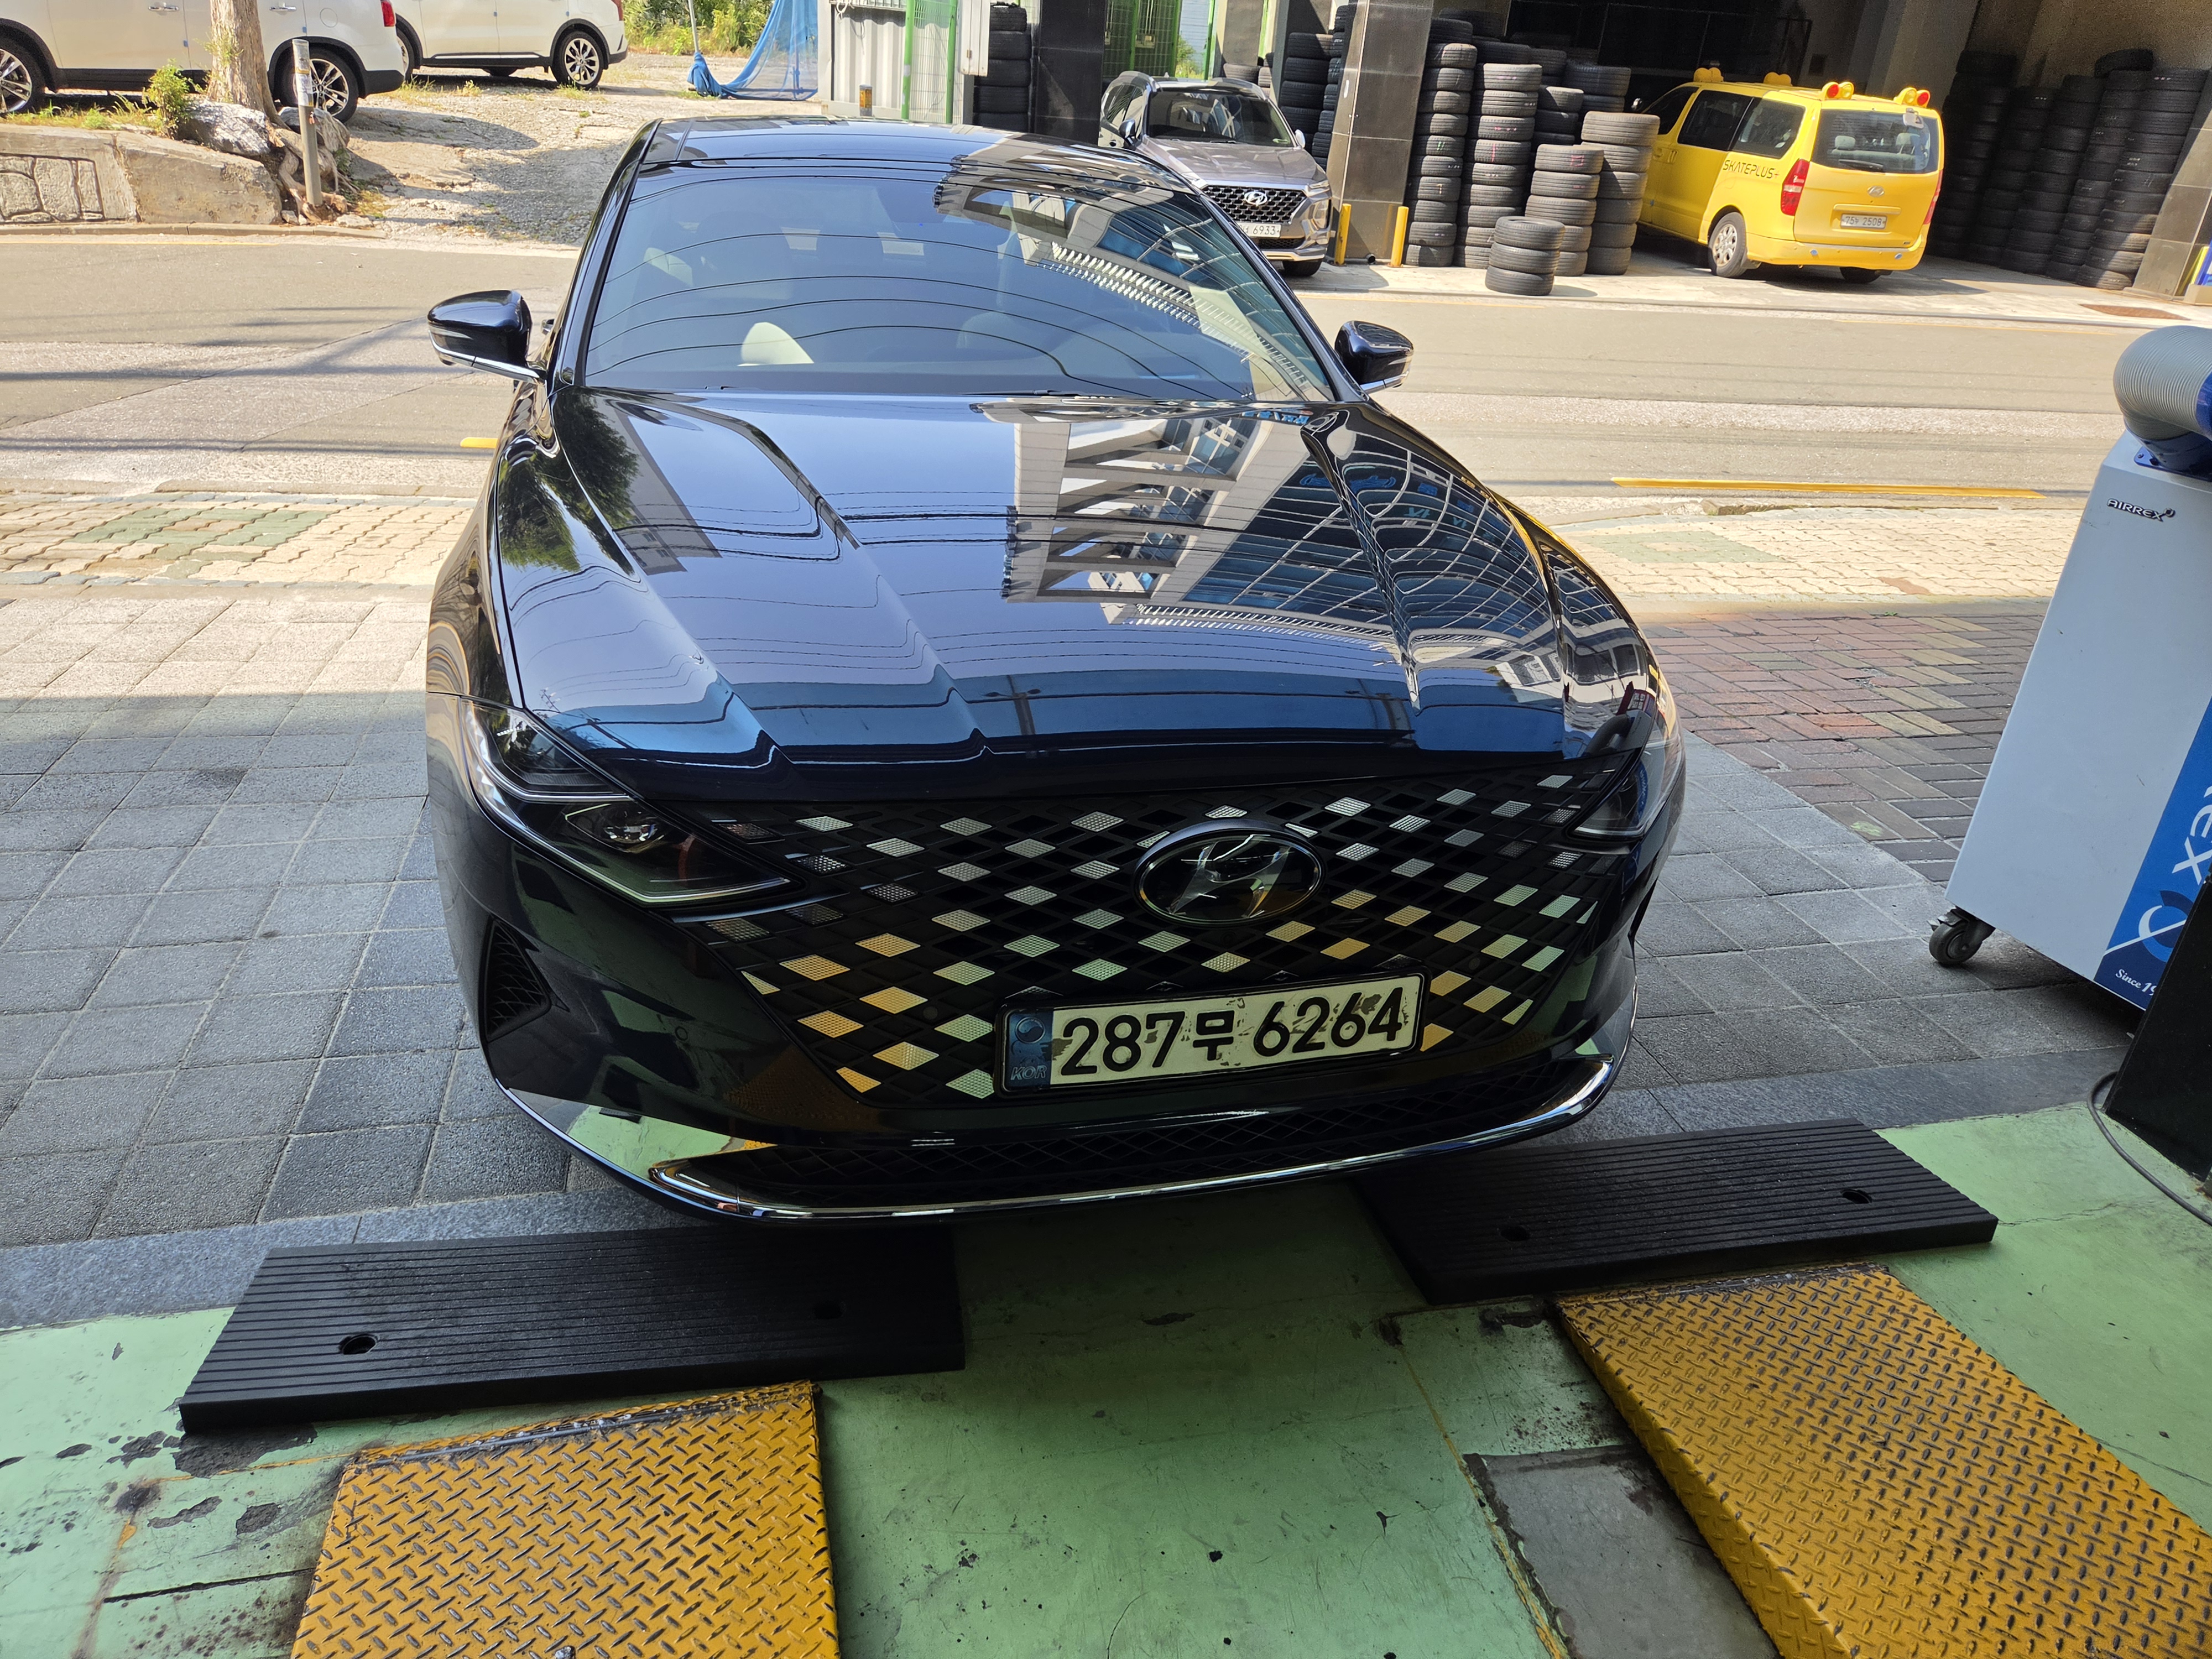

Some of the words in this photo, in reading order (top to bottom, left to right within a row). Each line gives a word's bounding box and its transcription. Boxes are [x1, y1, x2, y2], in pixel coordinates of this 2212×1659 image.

[1253, 225, 1276, 236] 6933
[1863, 217, 1882, 227] 2508
[2107, 498, 2164, 522] AIRREX
[2115, 969, 2142, 988] Since
[1061, 1010, 1235, 1076] 287무
[1253, 987, 1403, 1057] 6264
[1010, 1065, 1047, 1081] KOR
